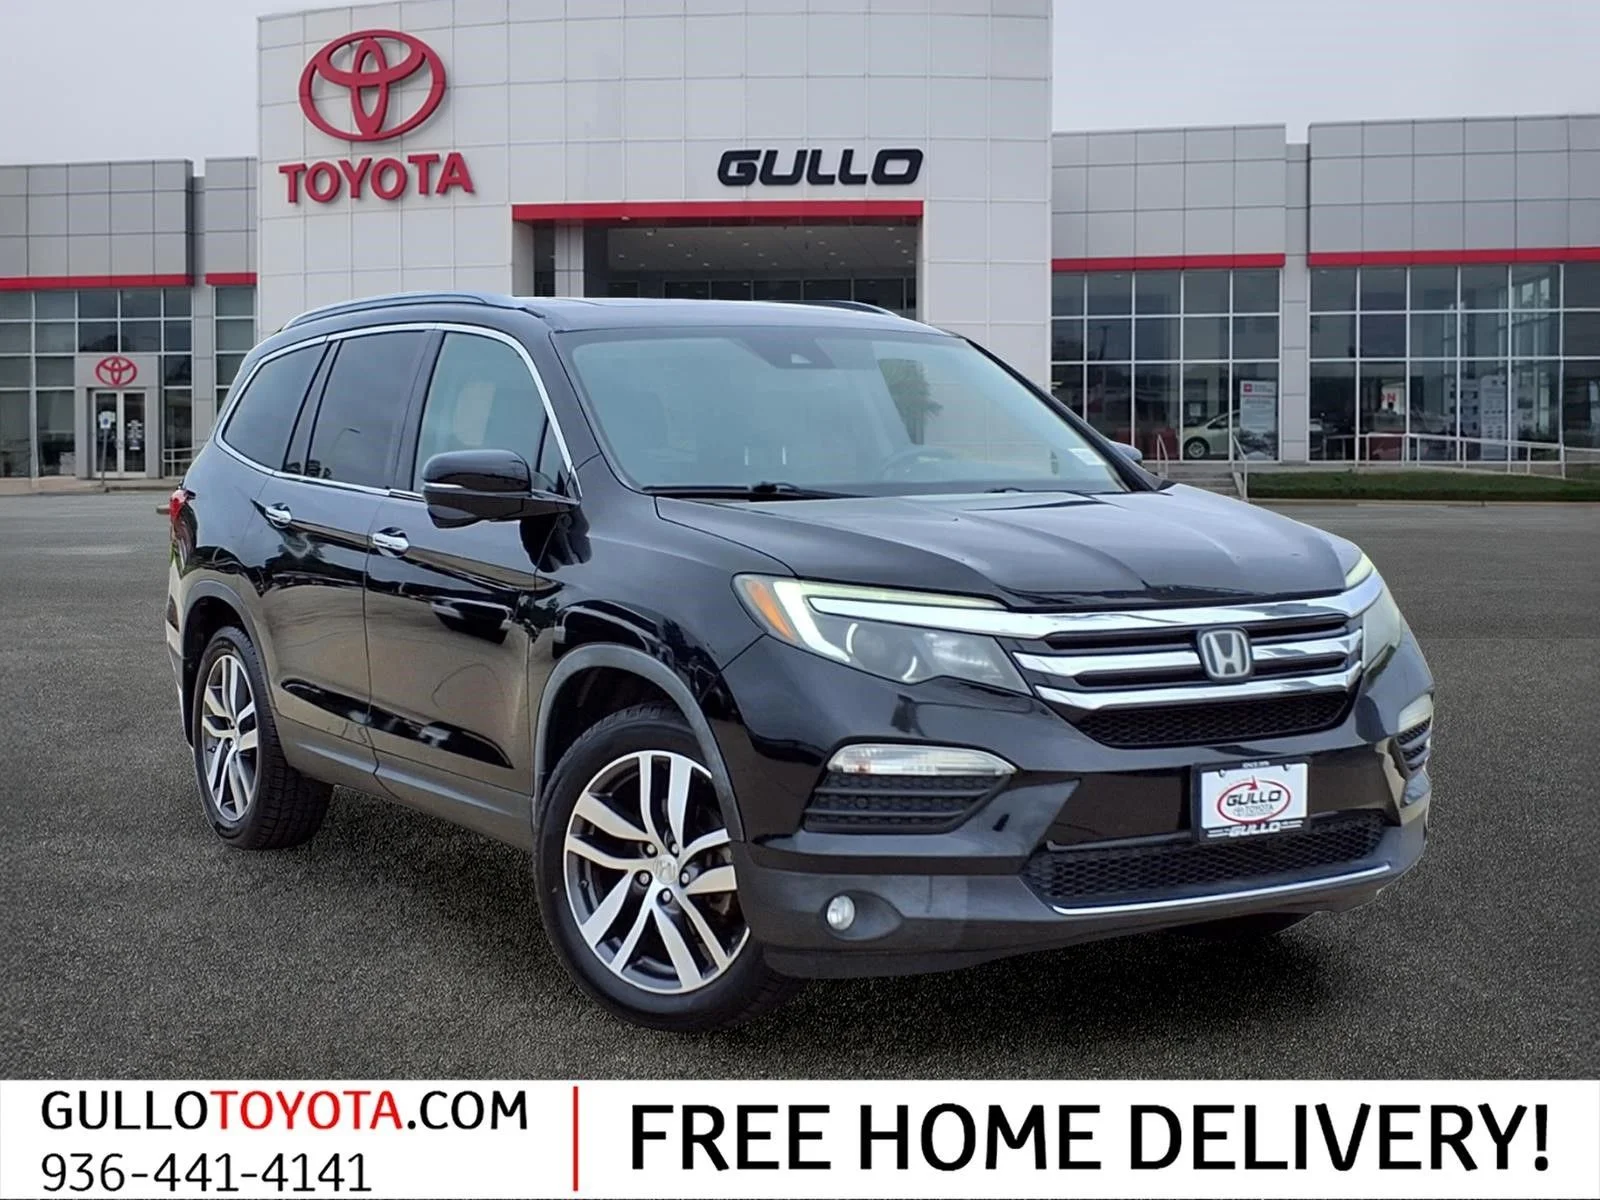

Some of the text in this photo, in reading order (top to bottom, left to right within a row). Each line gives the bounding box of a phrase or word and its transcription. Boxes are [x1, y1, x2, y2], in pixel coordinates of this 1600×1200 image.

[279, 151, 475, 204] TOYOTA
[717, 148, 924, 187] GULLO
[1227, 790, 1281, 806] GULLO
[1229, 822, 1281, 837] GULLO
